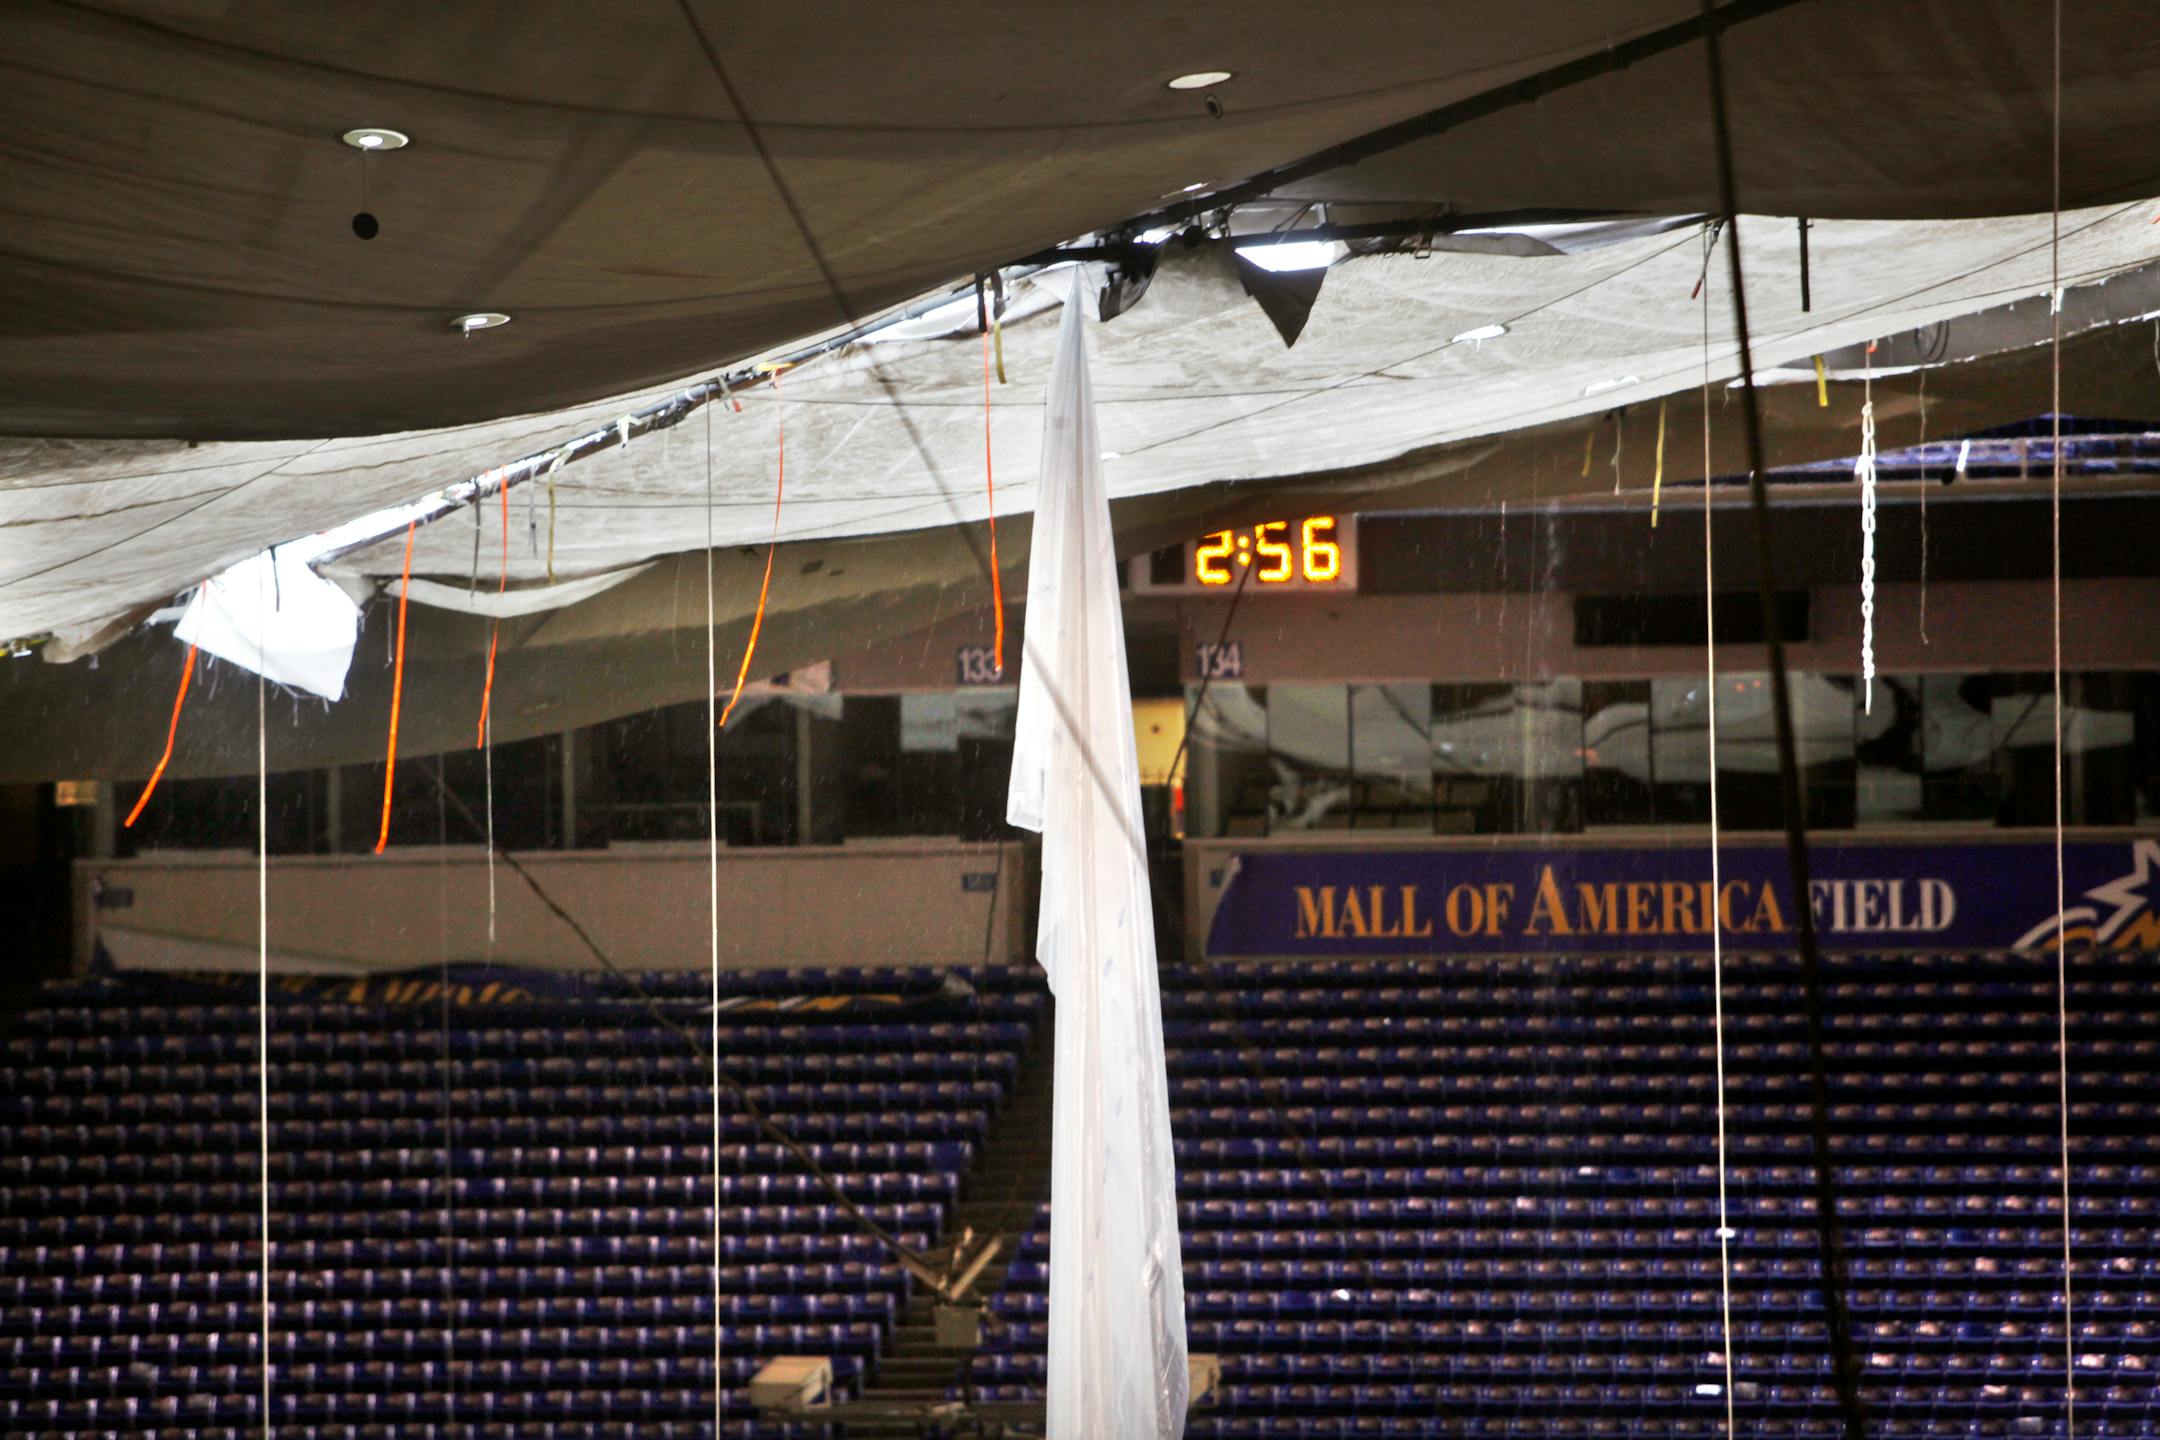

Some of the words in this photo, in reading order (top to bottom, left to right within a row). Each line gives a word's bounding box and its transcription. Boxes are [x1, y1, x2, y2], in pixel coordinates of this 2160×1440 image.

[1196, 516, 1341, 585] 2:56
[1195, 643, 1240, 676] 134
[1294, 885, 1433, 938] MALL
[1445, 883, 1515, 938] OF
[1522, 864, 1788, 936] AMERICA
[1807, 878, 1956, 933] FIELD
